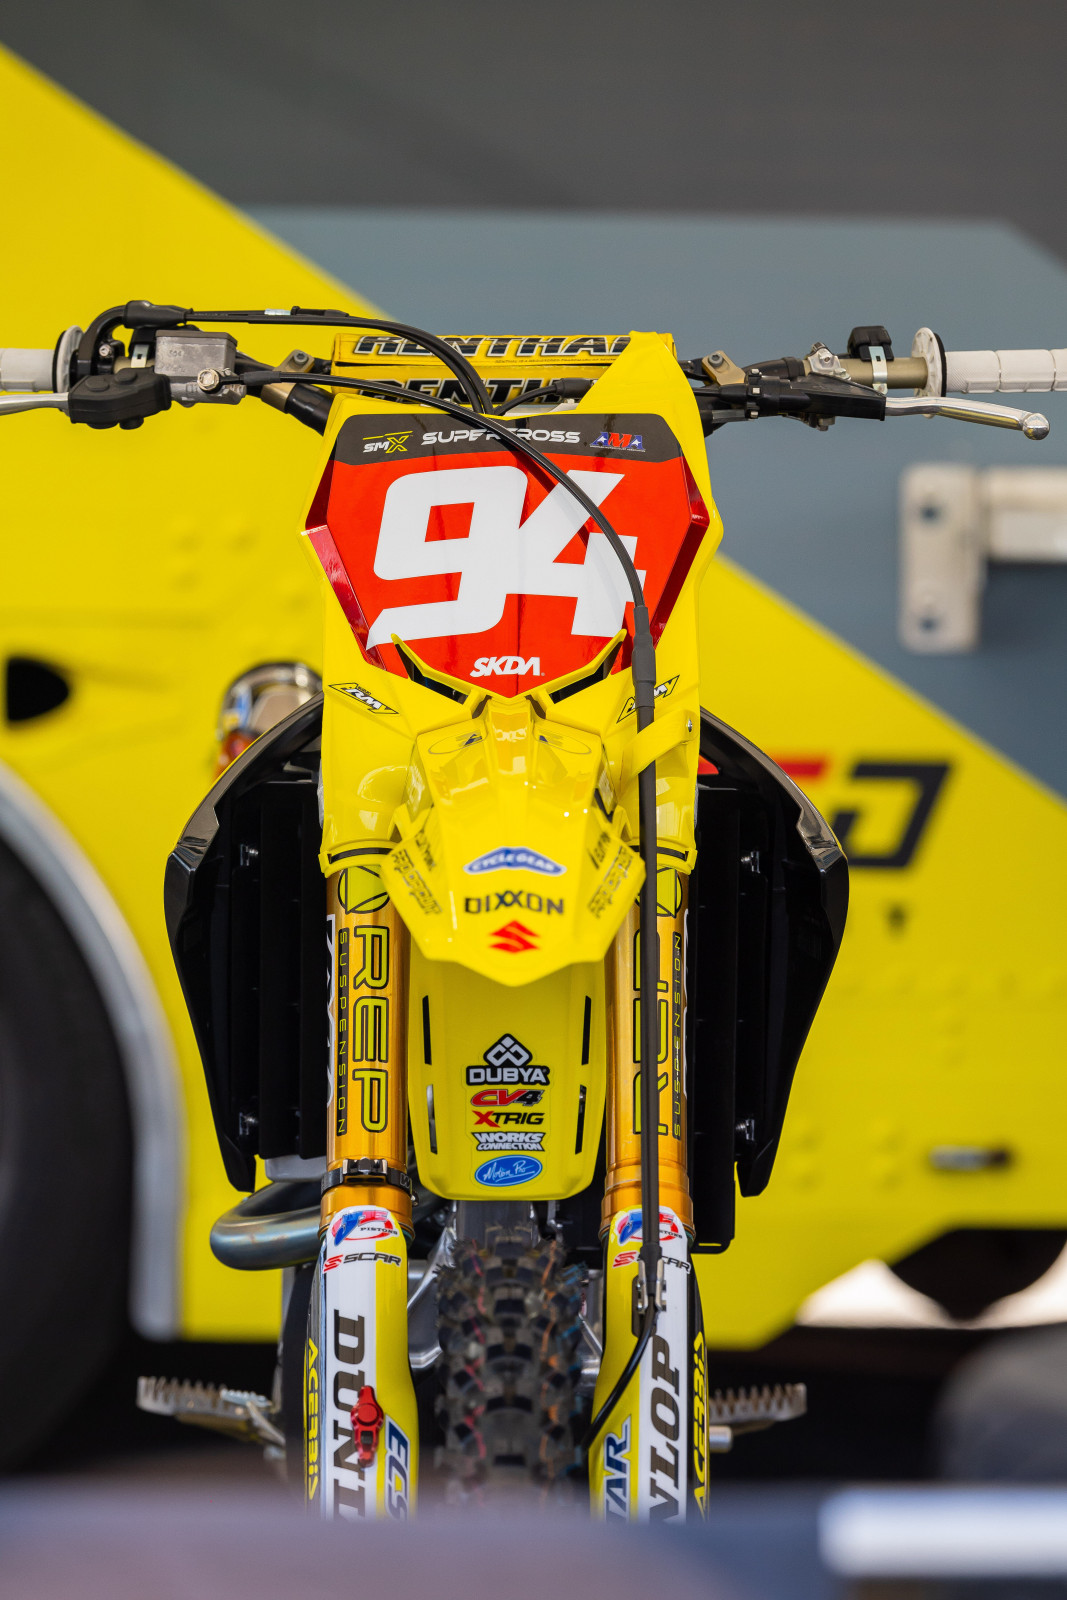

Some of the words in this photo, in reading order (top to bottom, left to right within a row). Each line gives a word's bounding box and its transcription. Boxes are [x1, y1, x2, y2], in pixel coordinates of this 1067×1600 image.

[363, 435, 409, 453] SMX
[590, 432, 643, 451] AMA
[366, 465, 647, 650] 94
[464, 890, 564, 915] DIXXON
[337, 930, 349, 1134] SUSPENSION
[352, 925, 389, 1133] REP
[673, 933, 681, 1139] SUSPENSION
[469, 1068, 547, 1083] DUBYA
[471, 1089, 545, 1106] CV4
[472, 1111, 545, 1128] XTRIG
[473, 1132, 544, 1143] WORKS
[477, 1142, 543, 1151] CONNECTION
[483, 1162, 512, 1181] Motion
[360, 1227, 398, 1235] PISTONS
[343, 1252, 402, 1266] SCAR
